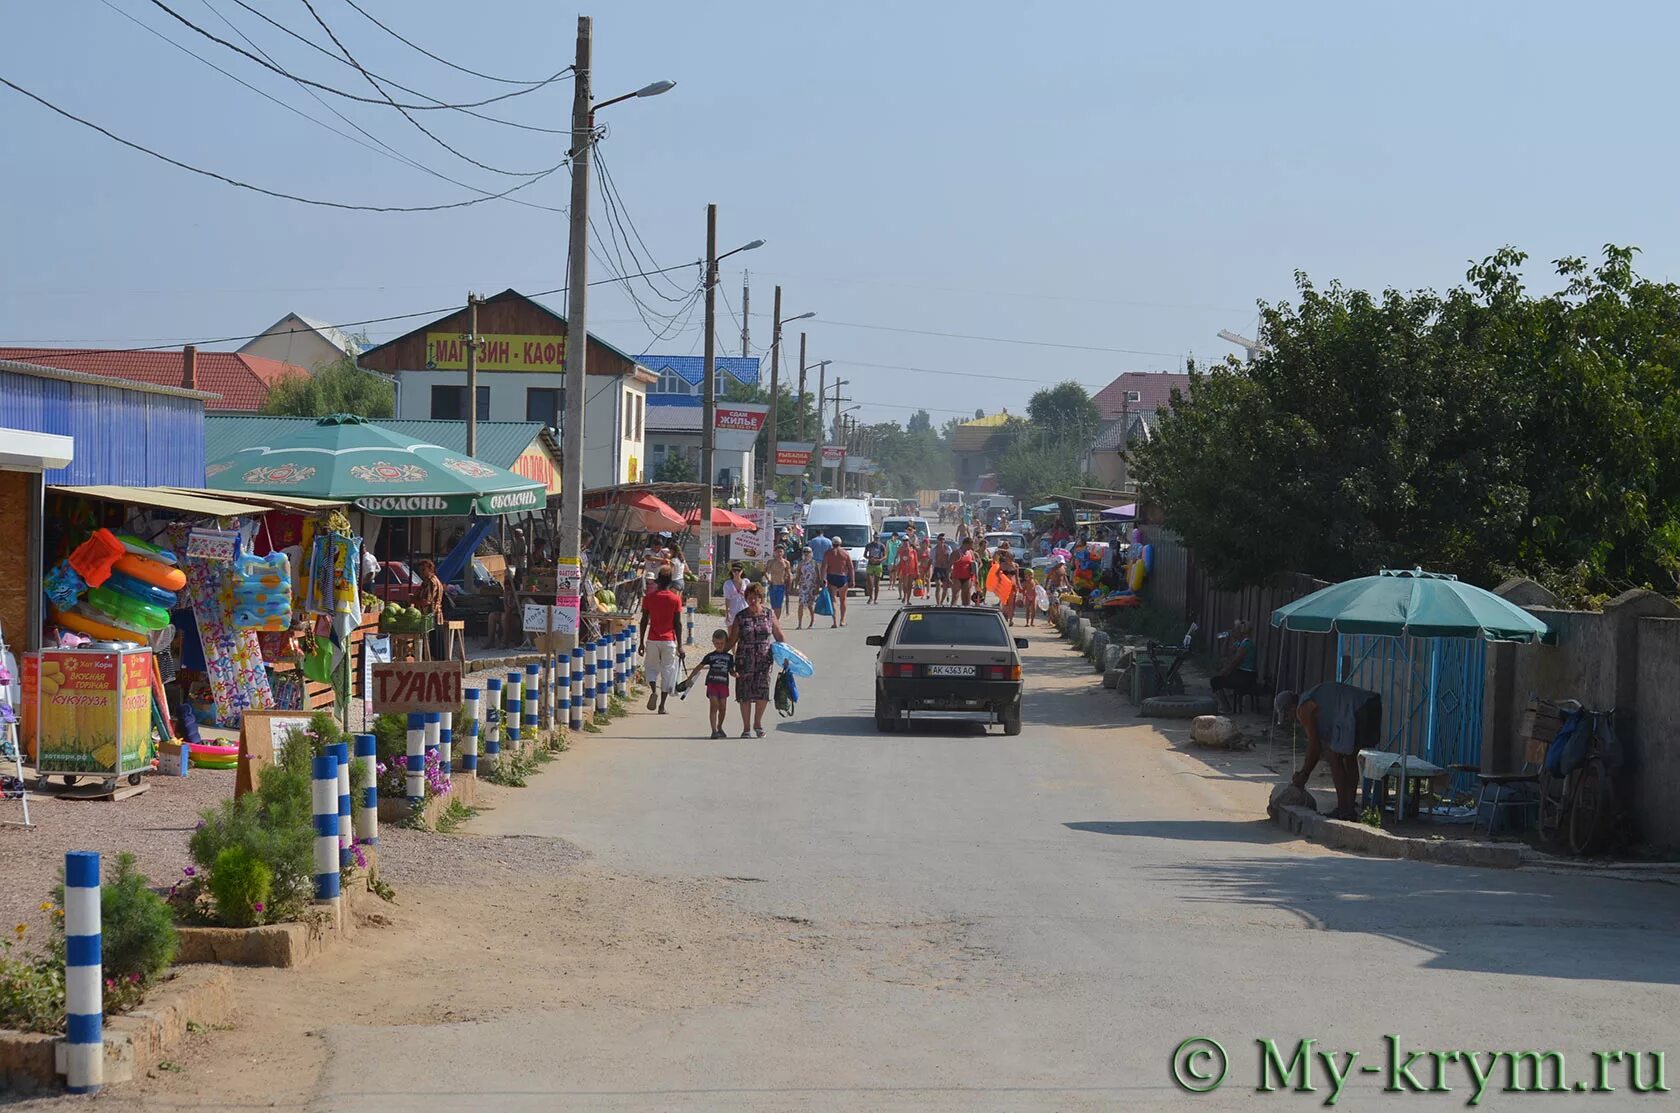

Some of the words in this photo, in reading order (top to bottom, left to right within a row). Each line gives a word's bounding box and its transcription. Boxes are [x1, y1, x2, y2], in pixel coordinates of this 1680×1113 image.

[436, 340, 509, 363] МАГЗИН
[523, 341, 565, 365] КАФЕ
[720, 416, 758, 427] ЖИЛЬЁ
[491, 491, 536, 509] ОБОЛОНЬ
[933, 666, 944, 674] AK
[945, 666, 962, 675] 4363
[71, 672, 106, 681] ВКУСНАЯ
[75, 681, 109, 690] ГОРЯЧАЯ
[51, 695, 108, 706] КУКУРУЗА
